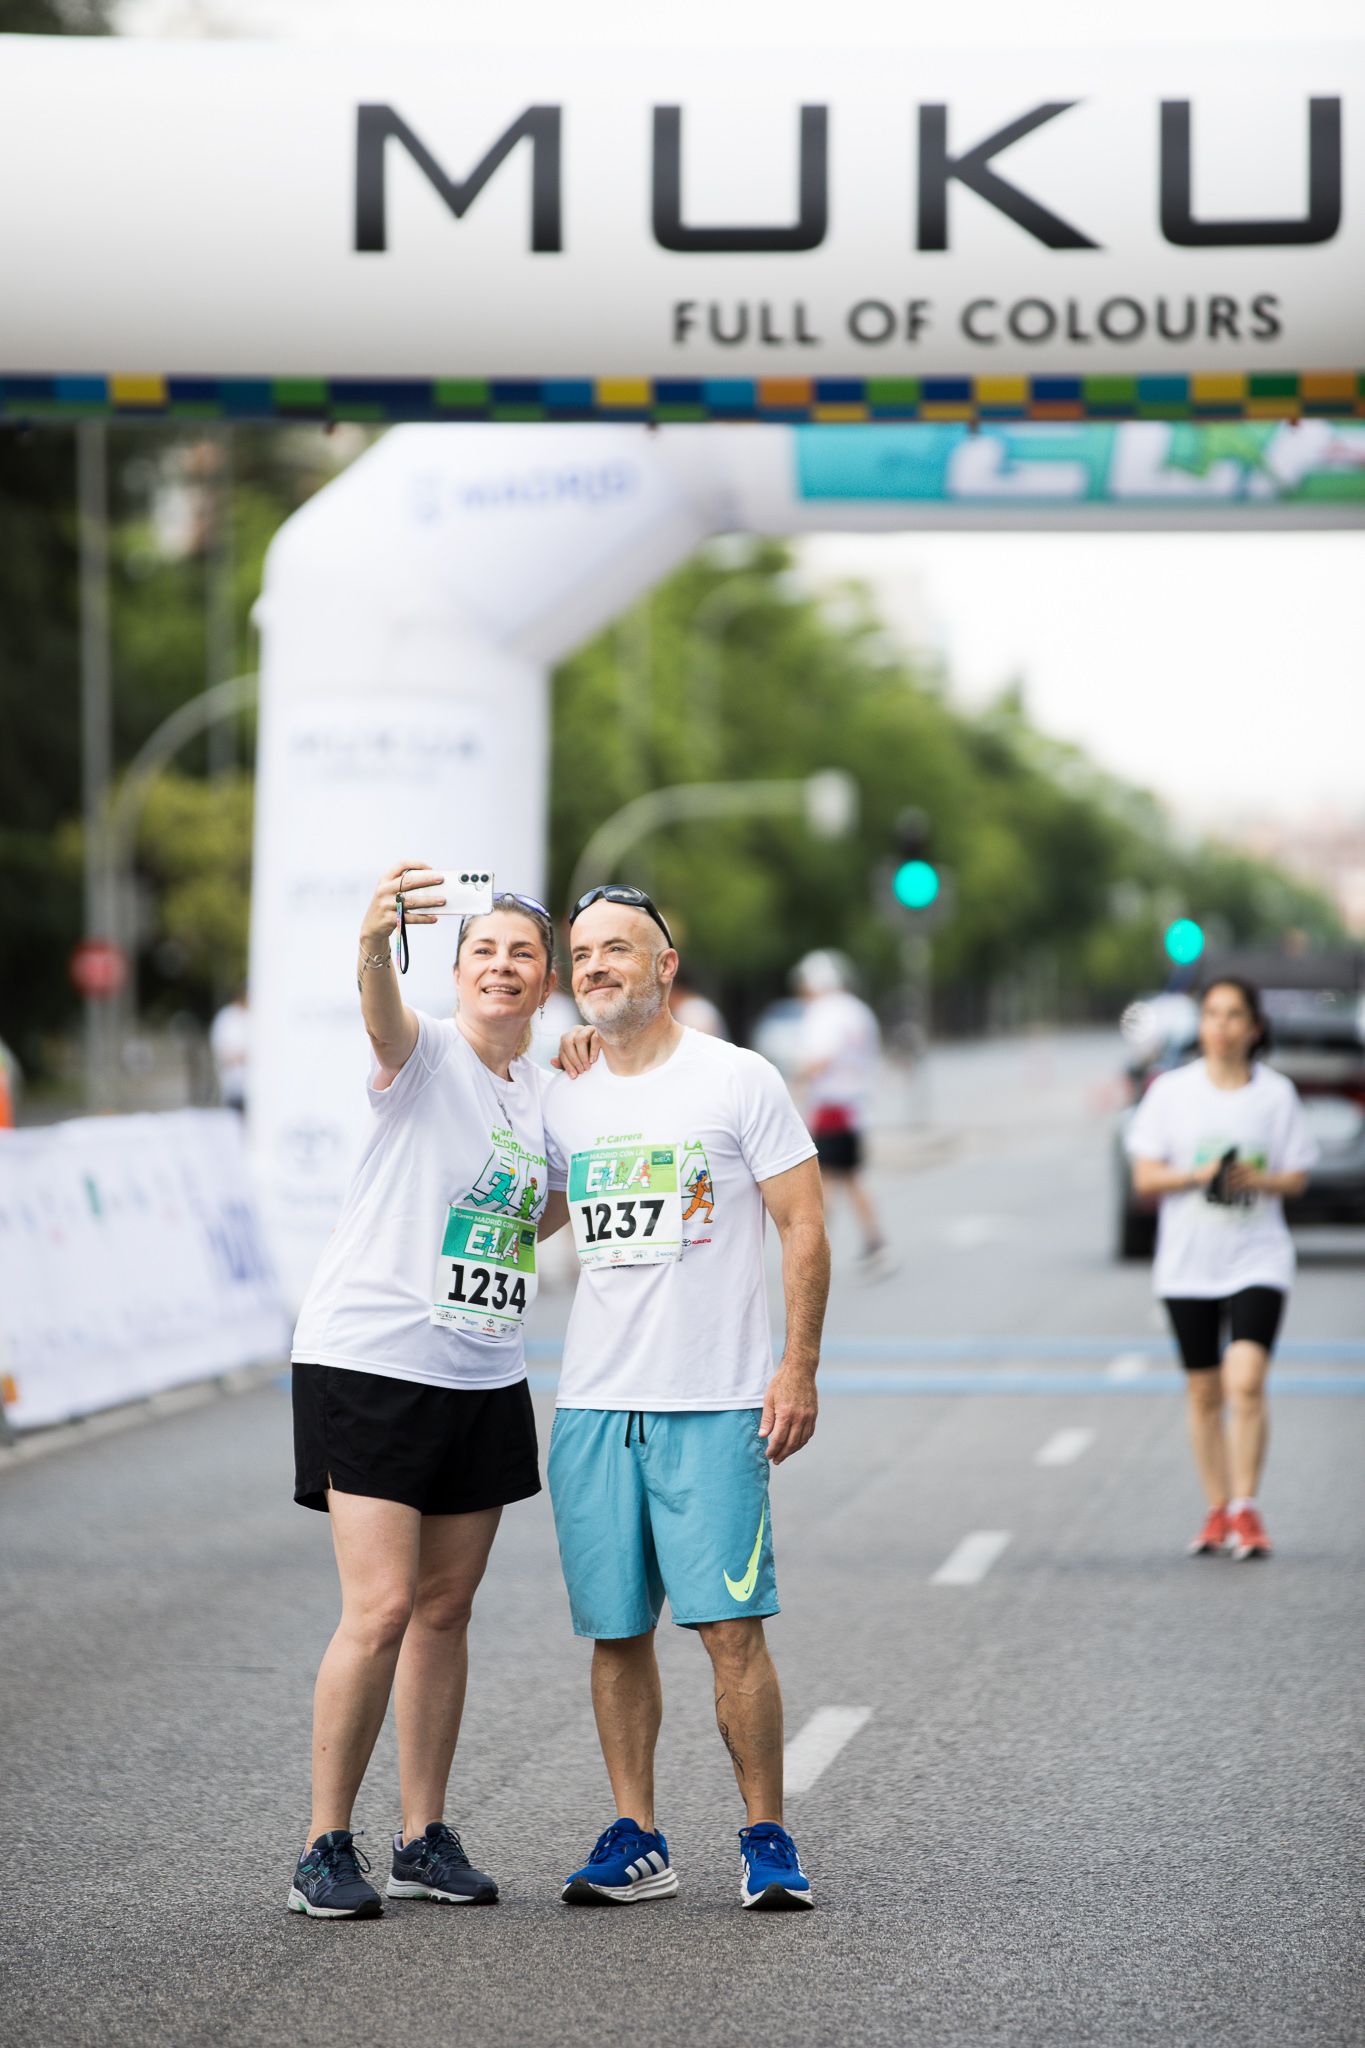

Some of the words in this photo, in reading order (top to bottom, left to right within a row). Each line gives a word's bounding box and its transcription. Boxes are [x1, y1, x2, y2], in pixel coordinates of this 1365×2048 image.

[671, 300, 822, 346] FULL
[847, 299, 931, 344] OF
[961, 294, 1282, 344] COLOURS
[684, 1139, 703, 1150] LA
[586, 1157, 651, 1193] ELA
[474, 1215, 503, 1226] MADRID
[581, 1199, 665, 1243] 1237
[464, 1223, 520, 1264] ELA
[448, 1263, 526, 1314] 1234
